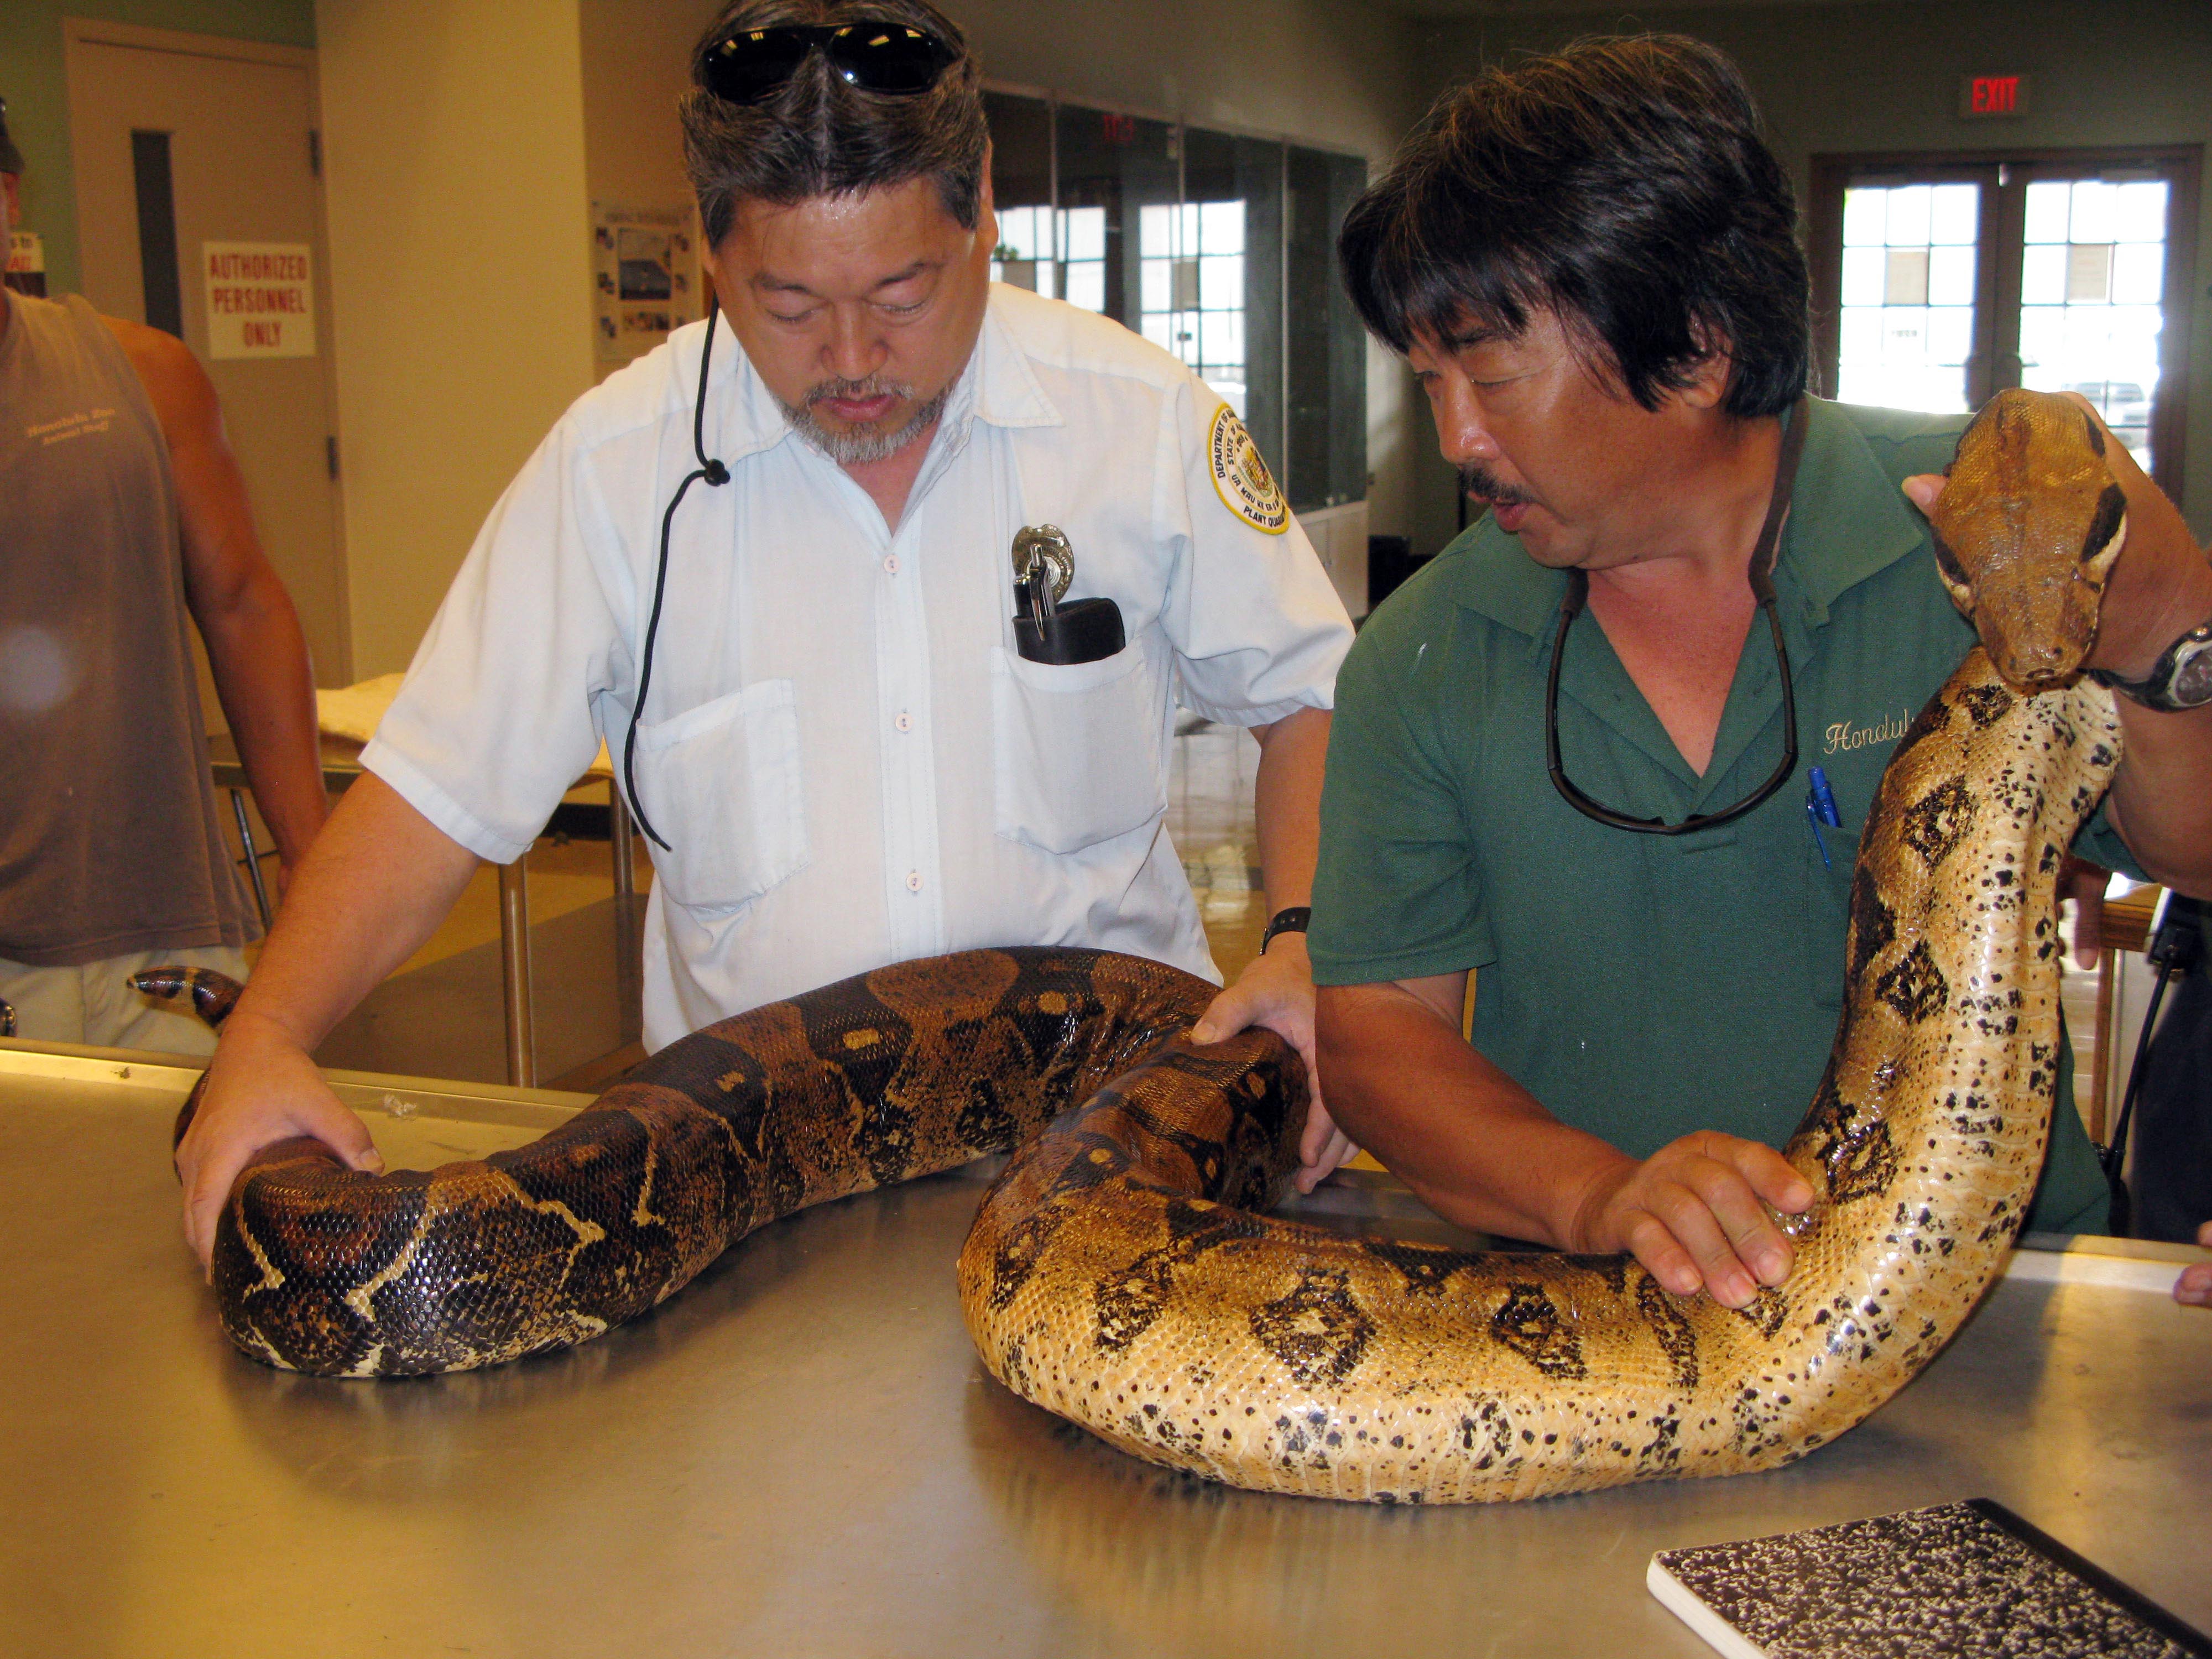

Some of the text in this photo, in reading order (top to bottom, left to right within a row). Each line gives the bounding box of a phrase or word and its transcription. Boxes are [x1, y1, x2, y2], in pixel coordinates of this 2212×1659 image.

[1972, 77, 2020, 113] EXIT
[210, 254, 306, 280] AUTHORIZED
[213, 287, 306, 314] PERSONNEL
[244, 321, 281, 348] ONLY
[1214, 420, 1225, 478] DEPARTMENT
[1243, 505, 1266, 525] PLANT
[1823, 708, 1914, 754] Honolul
